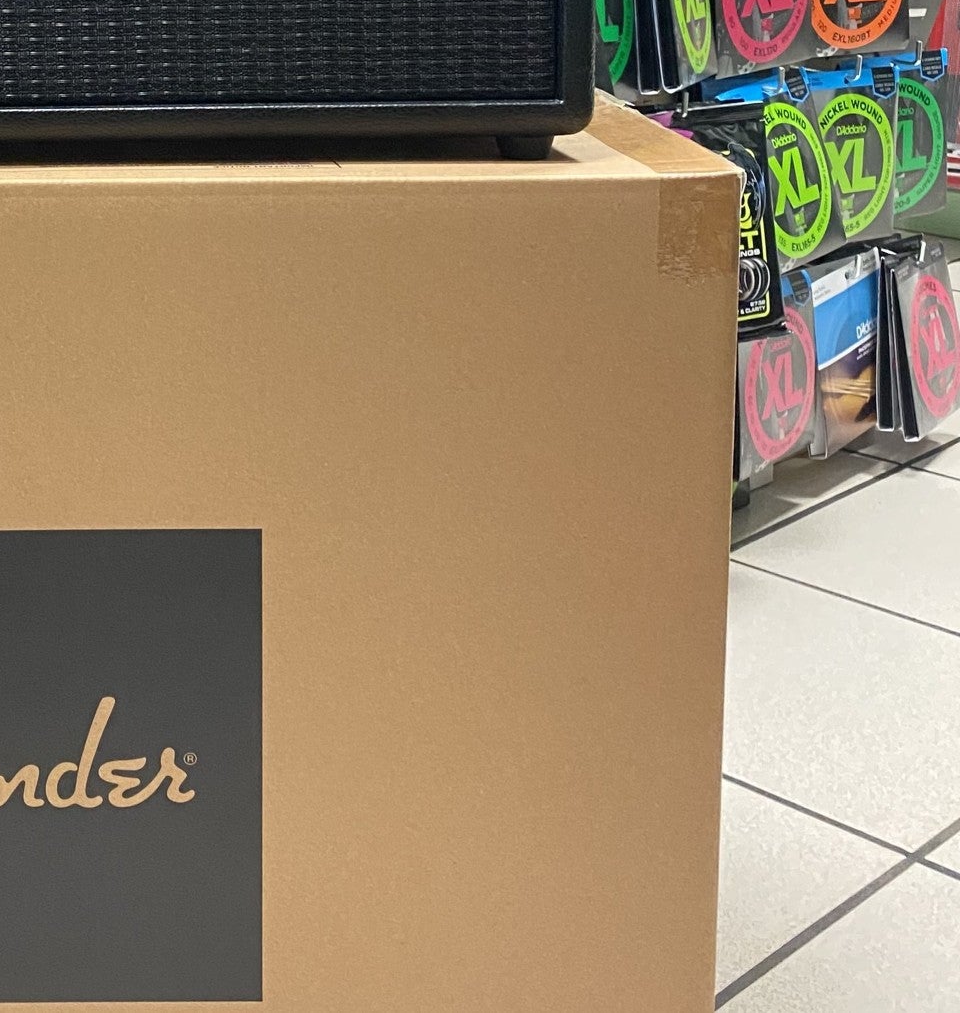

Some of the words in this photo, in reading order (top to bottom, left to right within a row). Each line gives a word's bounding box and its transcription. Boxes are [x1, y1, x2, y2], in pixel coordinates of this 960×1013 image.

[820, 99, 849, 130] NICKEL
[851, 98, 883, 126] WOUND
[898, 82, 931, 108] WOUND
[775, 108, 807, 131] WOUND
[768, 146, 820, 217] XL
[824, 137, 877, 195] XL
[760, 352, 805, 422] XL
